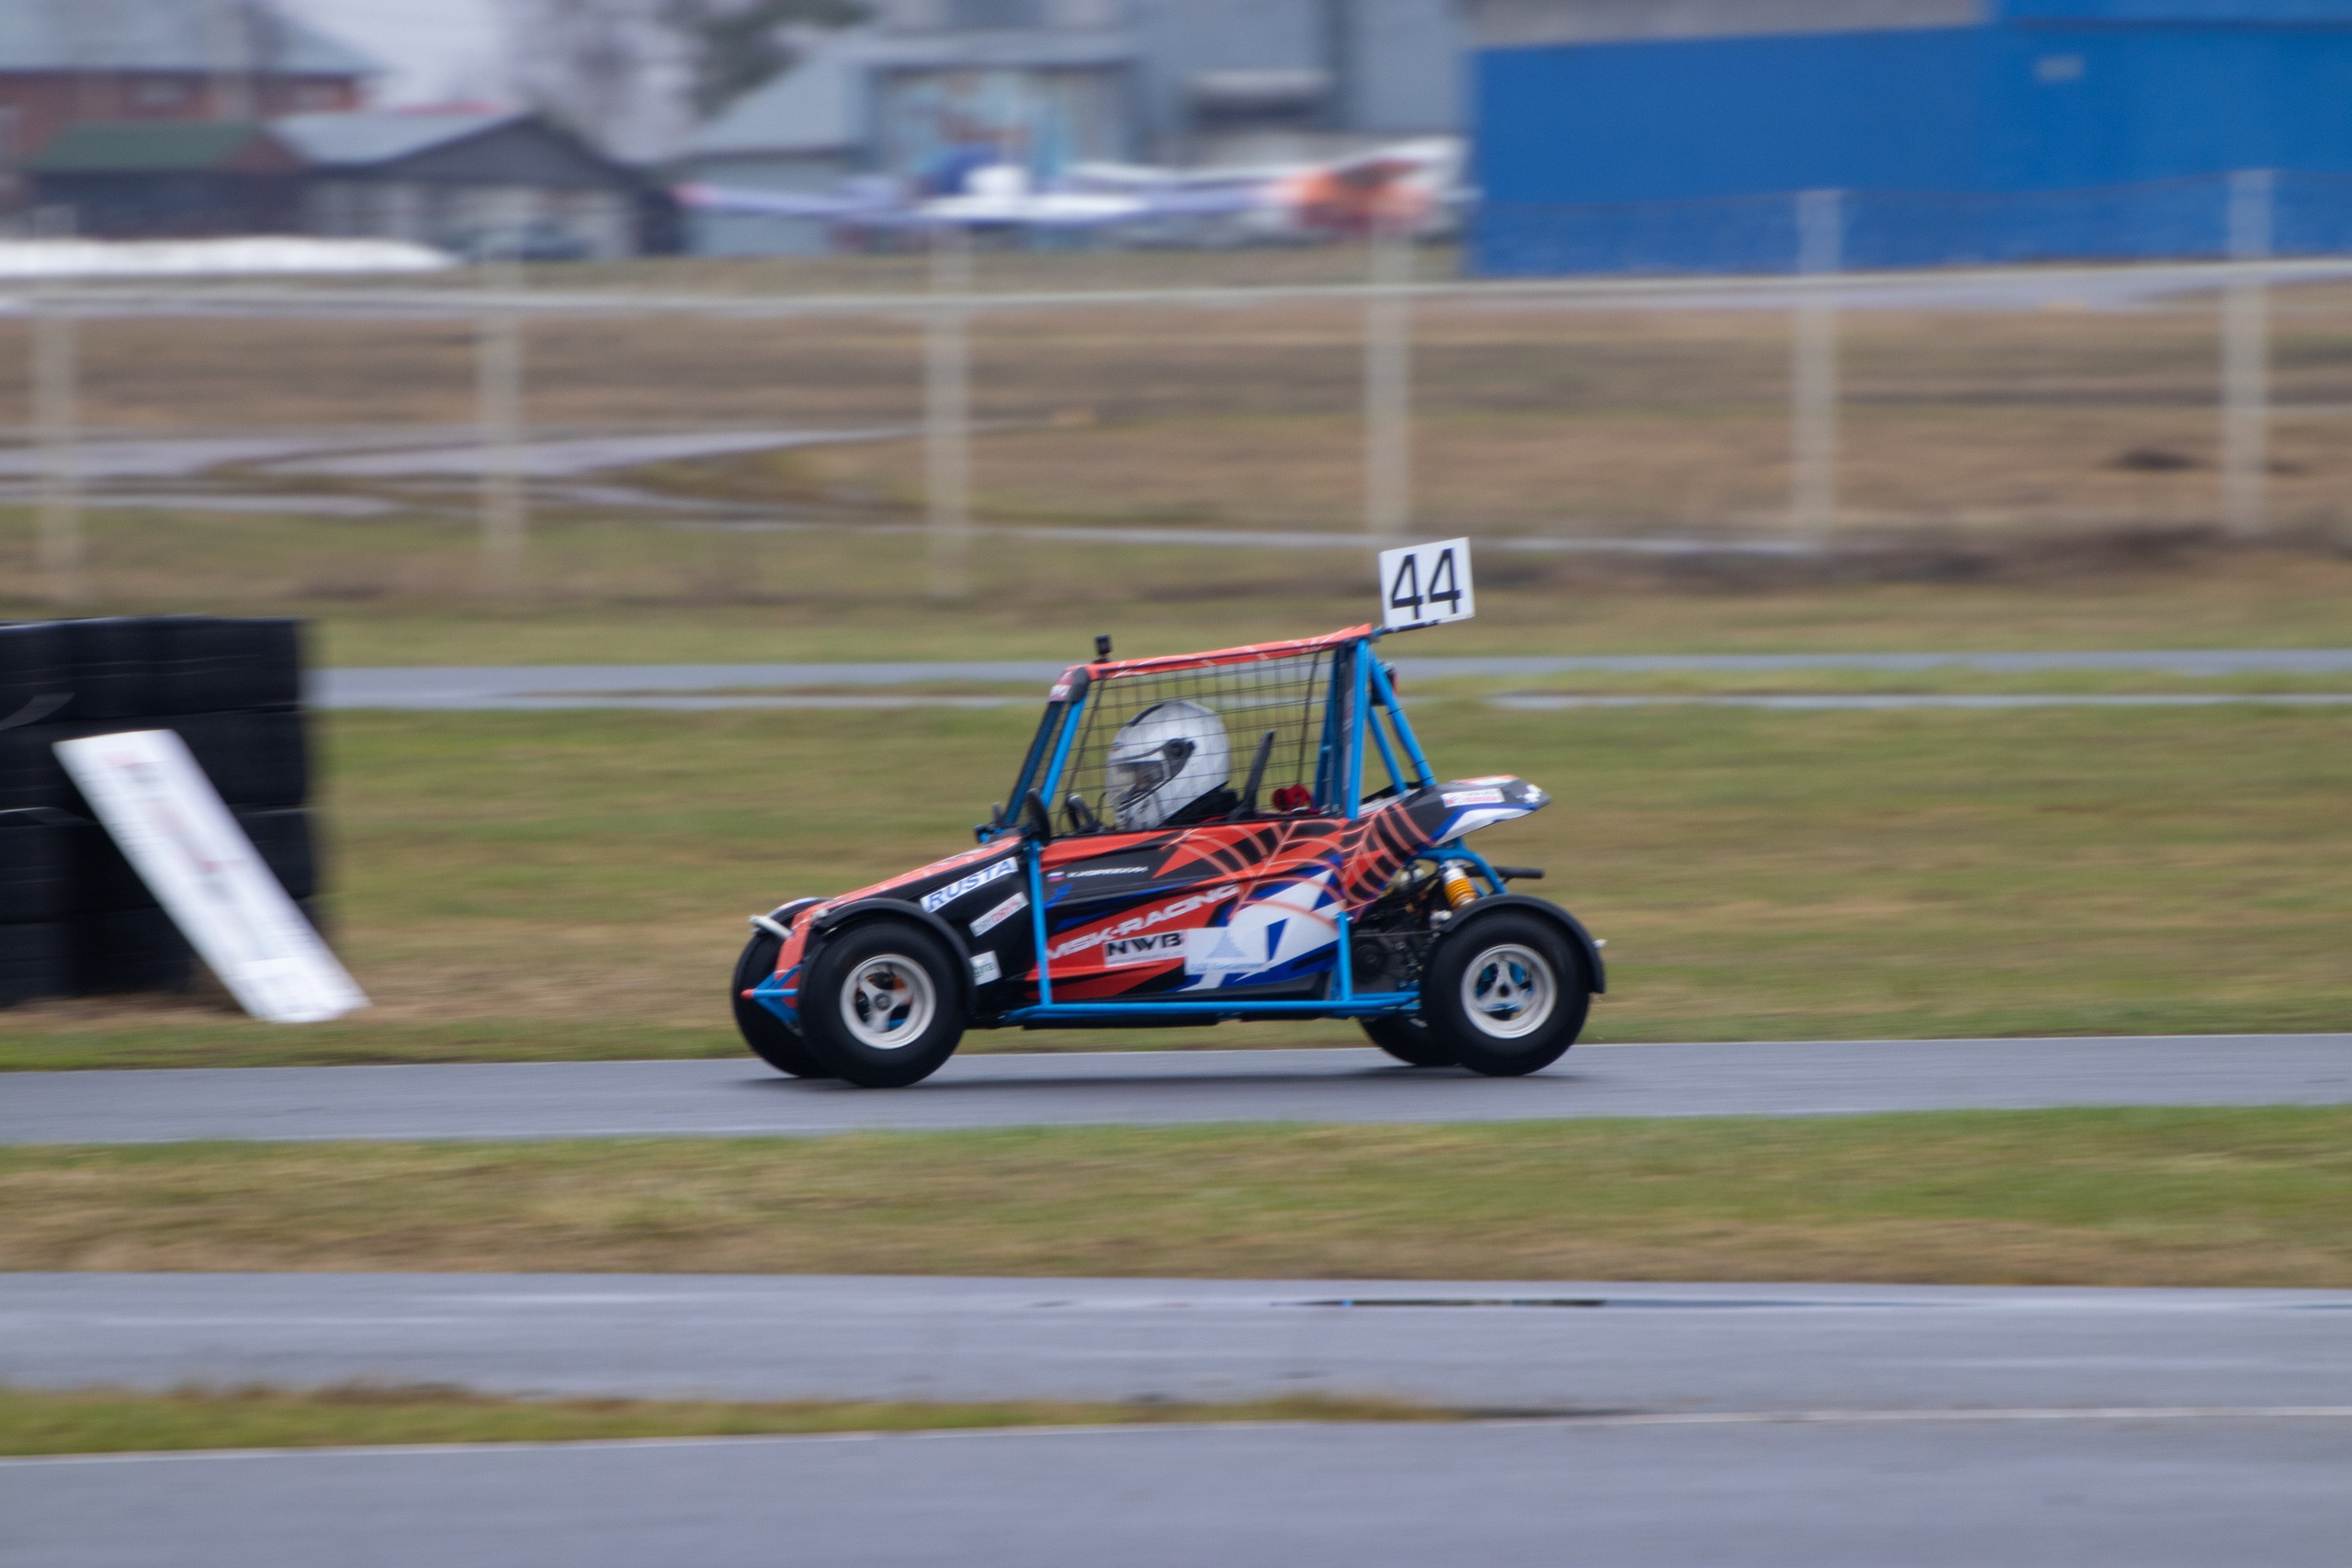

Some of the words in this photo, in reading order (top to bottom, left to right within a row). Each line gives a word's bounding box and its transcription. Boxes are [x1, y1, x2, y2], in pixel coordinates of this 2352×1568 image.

[1391, 547, 1461, 619] 44
[928, 860, 1012, 909] RUSTA
[1107, 931, 1182, 957] NWB
